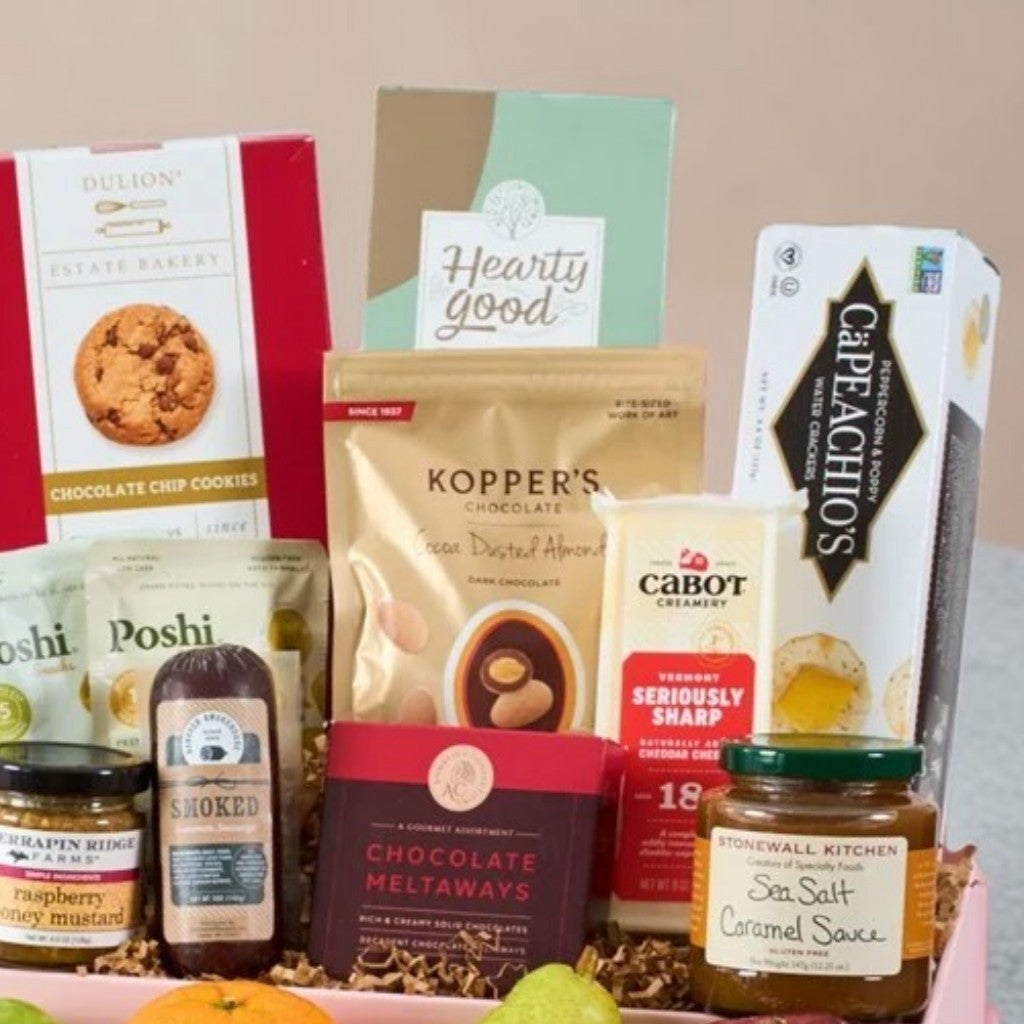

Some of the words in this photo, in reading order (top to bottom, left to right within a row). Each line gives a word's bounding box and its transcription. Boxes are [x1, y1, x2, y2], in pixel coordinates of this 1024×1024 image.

[50, 260, 128, 279] ESTATE
[139, 252, 221, 271] BAKERY
[443, 243, 590, 294] Hearty
[435, 286, 558, 341] good
[809, 376, 826, 417] WATER
[870, 360, 893, 446] PEPPERCORN
[804, 420, 822, 481] CRACKERS
[50, 484, 146, 502] CHOCOLATE
[150, 479, 187, 494] CHIP
[191, 473, 258, 491] COOKIES
[428, 468, 600, 496] KOPPER'S
[465, 501, 563, 515] CHOCOLATE
[544, 533, 608, 562] Almond
[499, 577, 562, 588] CHOCOLATE
[657, 598, 727, 608] CREAMERY
[109, 612, 215, 653] Poshi
[632, 687, 744, 706] SERIOUSLY
[652, 708, 723, 726] SHARP
[171, 797, 259, 819] SMOKED
[659, 782, 703, 811] 18
[87, 836, 135, 850] RIDGE
[718, 836, 816, 856] STONEWALL
[824, 844, 898, 857] KITCHEN
[31, 853, 94, 863] FARMS
[366, 843, 537, 872] CHOCOLATE
[14, 887, 105, 910] raspberry
[366, 873, 530, 902] MELTAWAYS
[747, 874, 795, 901] Sea
[798, 876, 855, 906] Salt
[50, 907, 124, 926] mustard
[393, 916, 431, 927] CREAMY
[434, 920, 463, 930] SOLID
[720, 904, 803, 943] Caramel
[812, 915, 886, 946] Sauce
